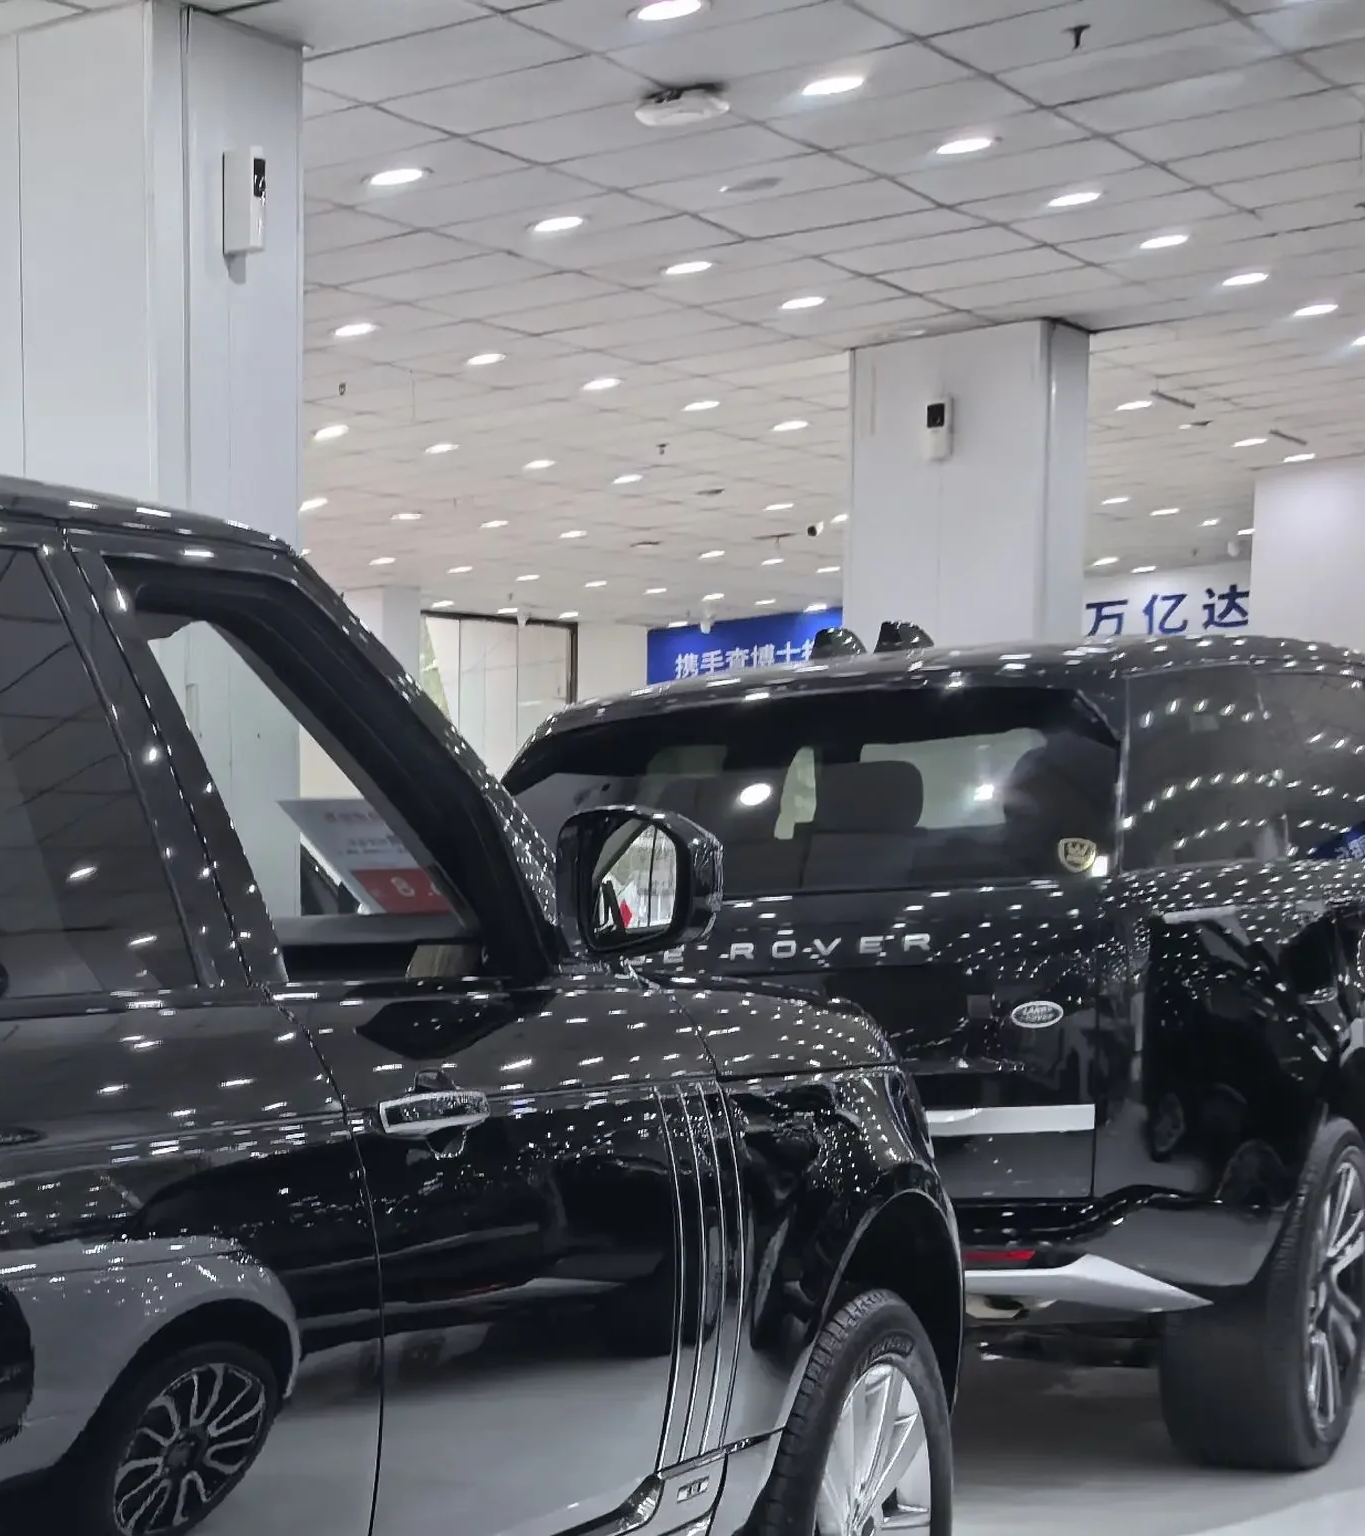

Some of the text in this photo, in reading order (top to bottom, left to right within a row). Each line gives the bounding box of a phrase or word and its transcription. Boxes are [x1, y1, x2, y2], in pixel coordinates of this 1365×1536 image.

[1086, 584, 1250, 637] 万亿达
[729, 933, 931, 961] ROVER
